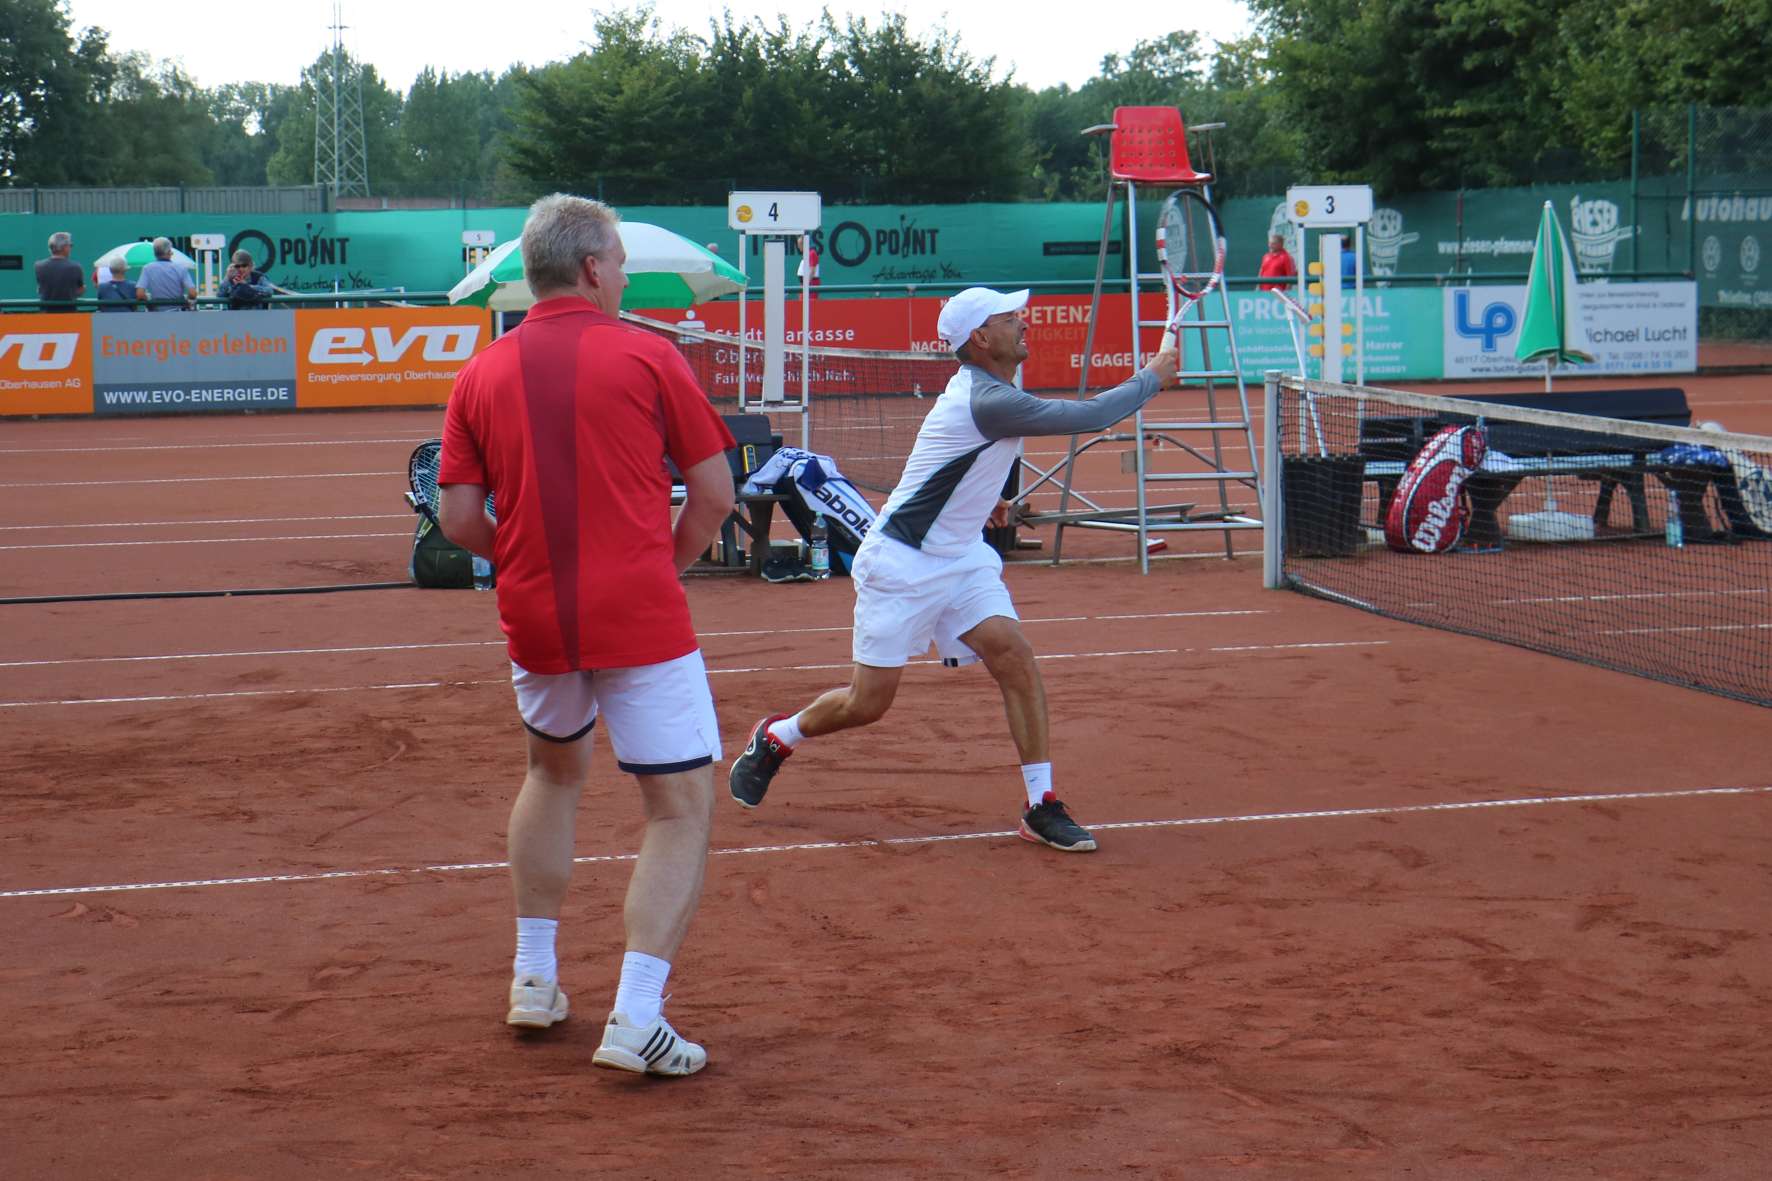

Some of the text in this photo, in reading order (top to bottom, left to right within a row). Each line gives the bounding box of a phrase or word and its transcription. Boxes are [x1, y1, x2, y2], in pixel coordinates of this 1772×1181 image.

[768, 202, 778, 222] 4
[1325, 195, 1336, 215] 3
[1644, 326, 1687, 342] Lucht
[103, 332, 288, 361] Energie erleben
[308, 325, 481, 367] evo
[65, 378, 81, 388] AG
[308, 371, 401, 385] Energieversorgung
[103, 387, 289, 405] WWW.EVO-ENERGIE.DE
